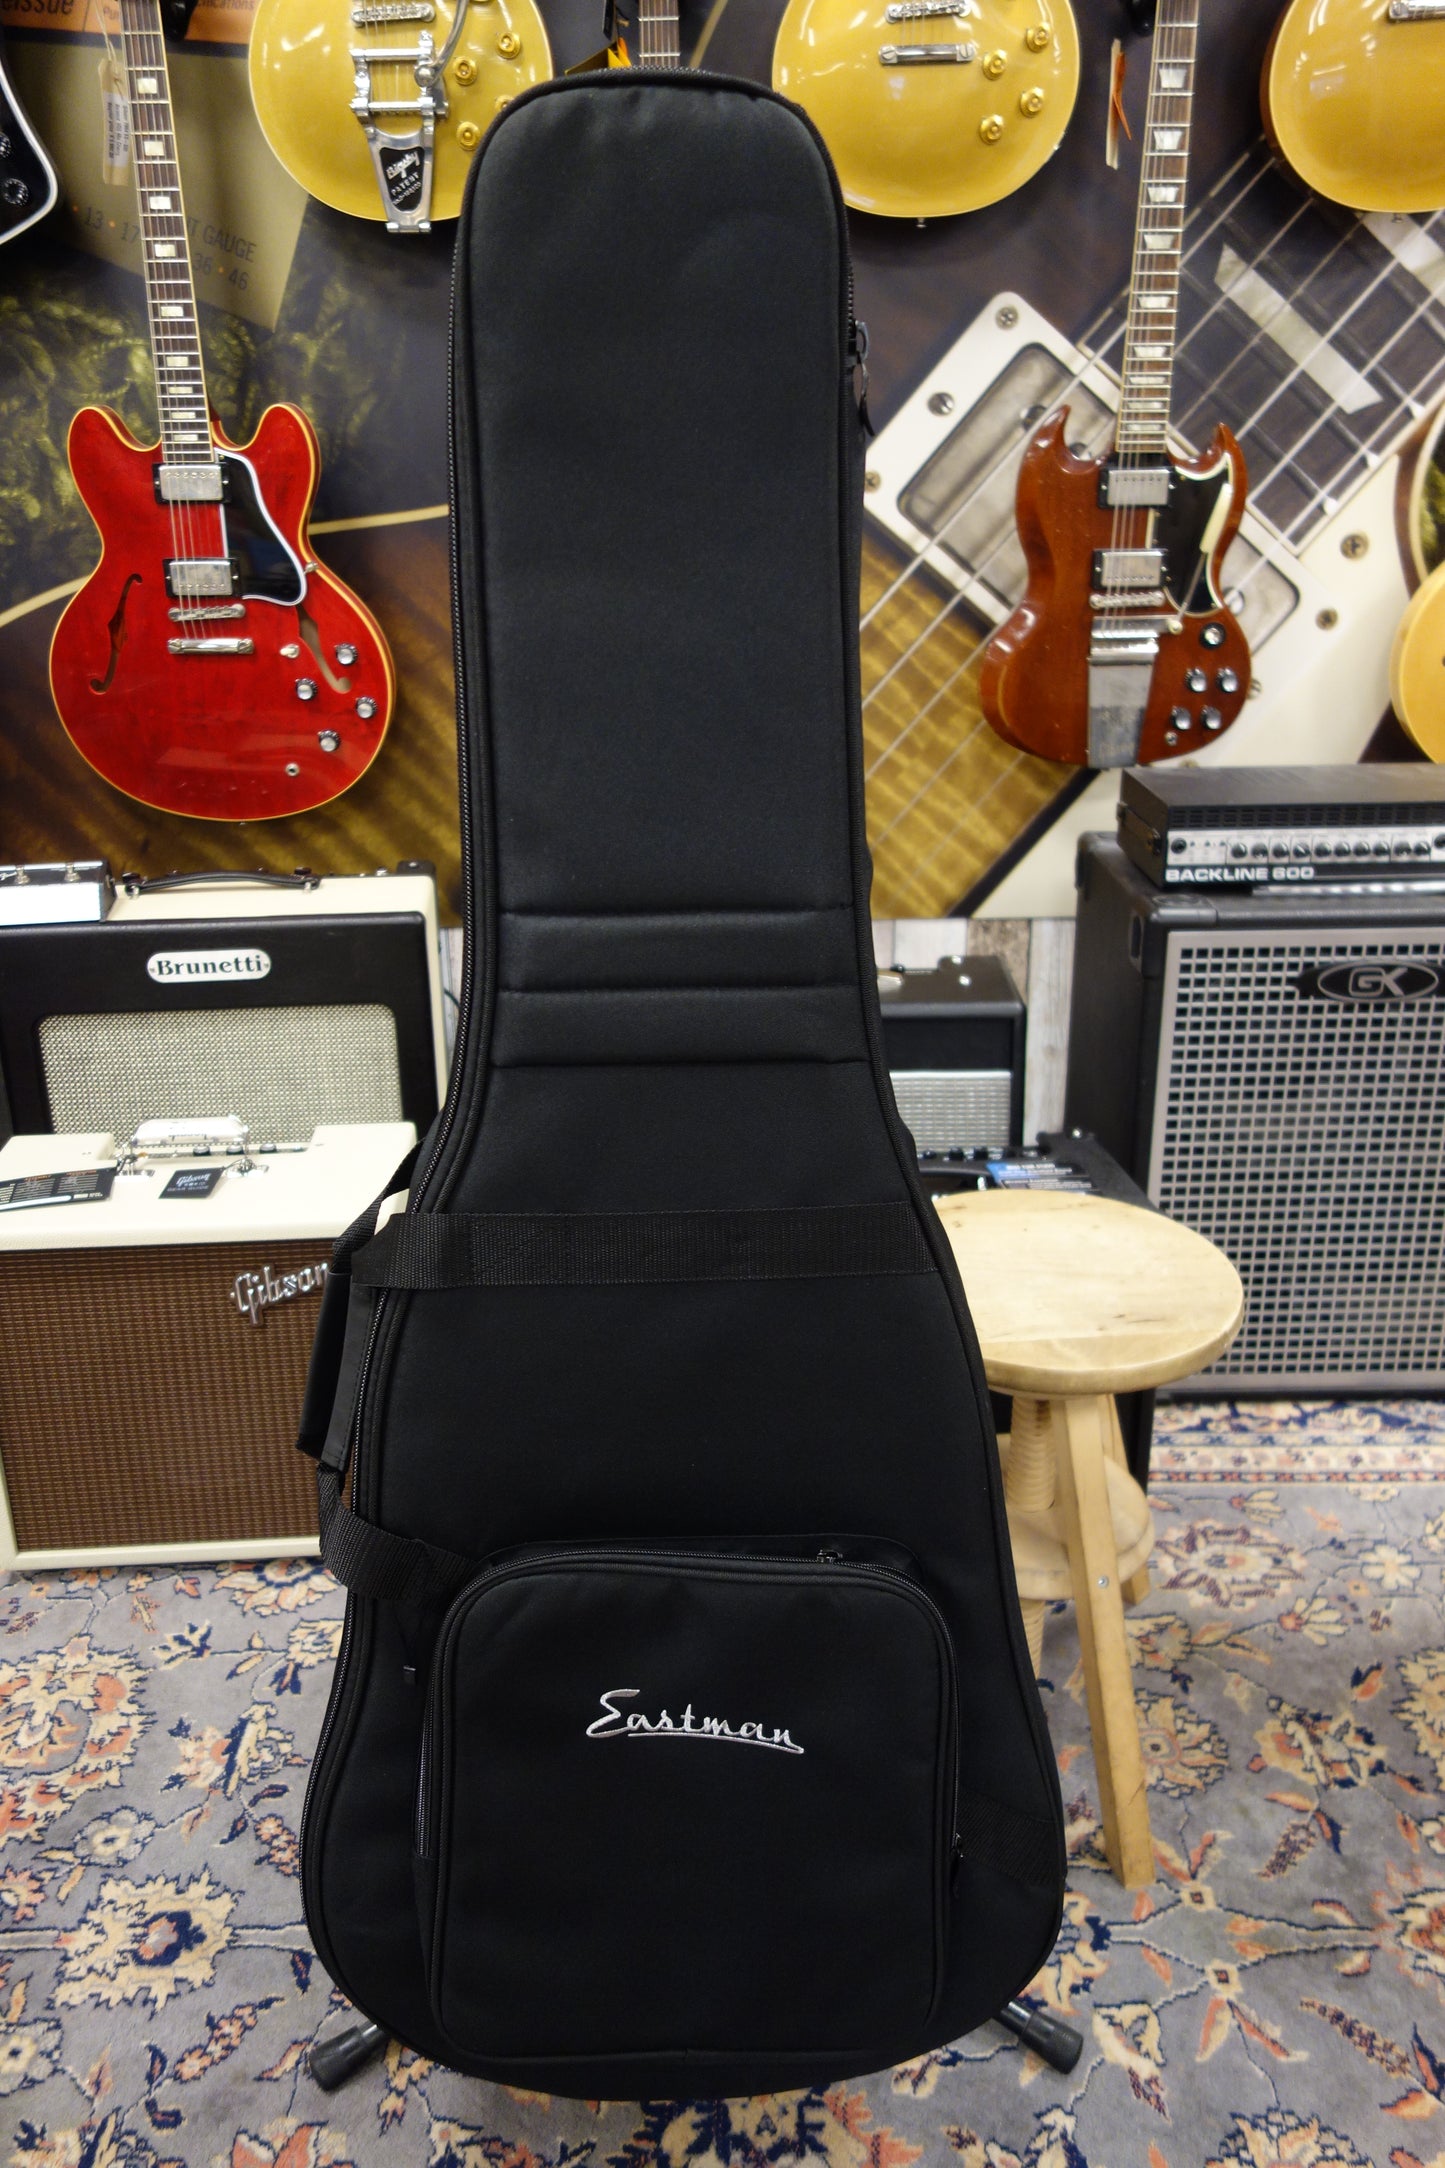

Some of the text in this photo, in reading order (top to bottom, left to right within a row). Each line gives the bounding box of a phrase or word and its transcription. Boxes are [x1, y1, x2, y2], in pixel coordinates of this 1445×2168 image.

[202, 224, 257, 263] GAUGE
[229, 268, 250, 291] 46
[1165, 866, 1314, 882] BACKLINE 600
[157, 955, 262, 976] Brunetti
[1349, 966, 1408, 998] GK
[230, 1263, 329, 1325] Gibson
[586, 1689, 804, 1754] Eastman
